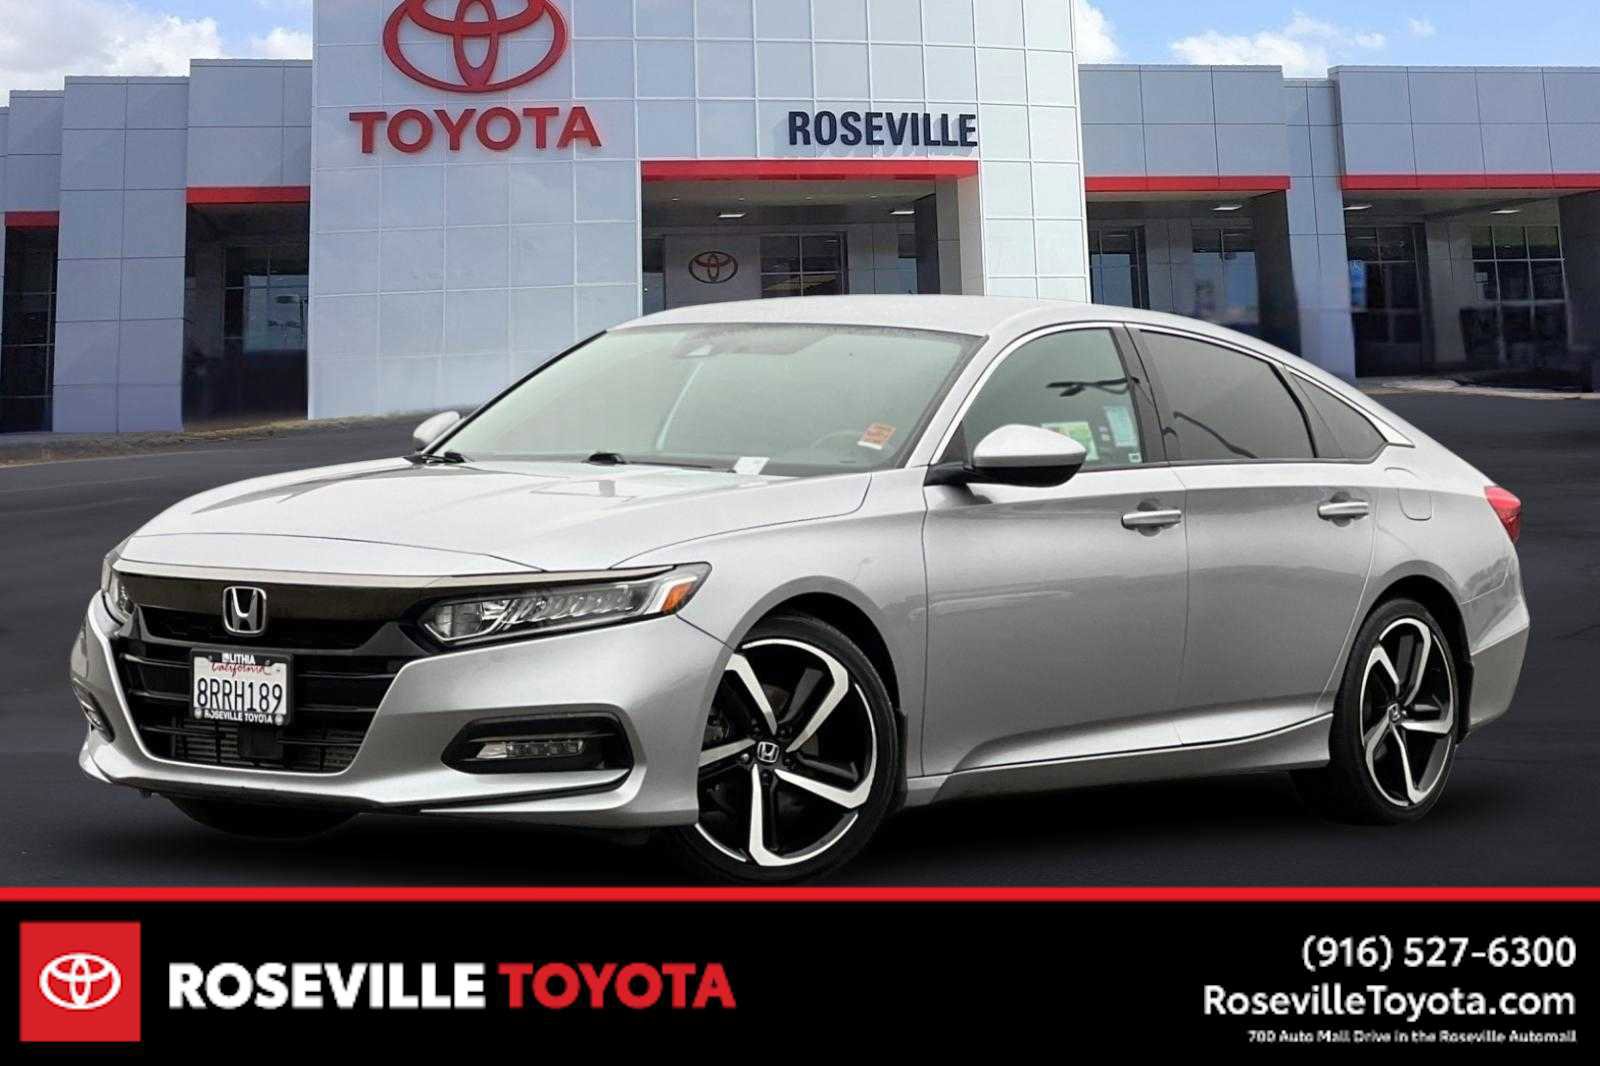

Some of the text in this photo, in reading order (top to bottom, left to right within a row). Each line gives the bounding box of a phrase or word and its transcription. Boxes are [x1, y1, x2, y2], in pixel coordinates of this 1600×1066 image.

[348, 106, 602, 153] TOYOTA
[788, 110, 978, 147] ROSEVILLE
[197, 677, 283, 714] 8RRH189
[204, 709, 273, 724] ROSEVILLE TOYOTA
